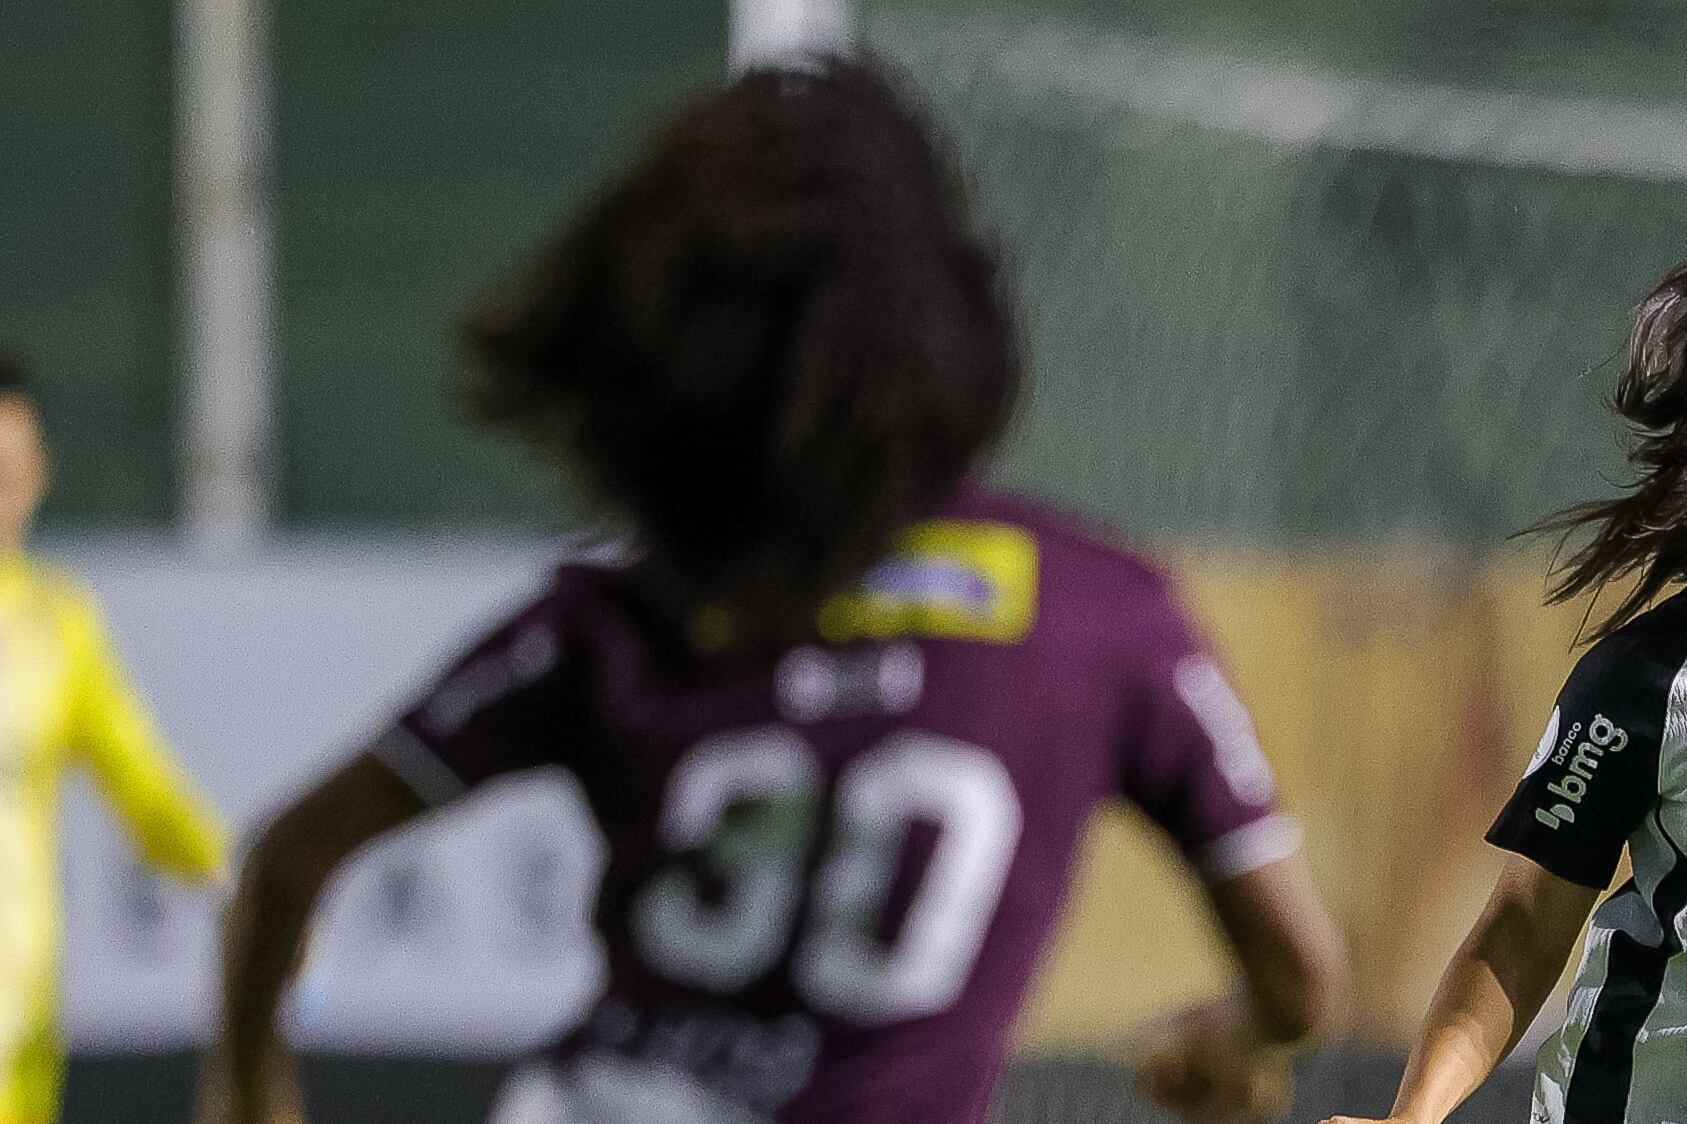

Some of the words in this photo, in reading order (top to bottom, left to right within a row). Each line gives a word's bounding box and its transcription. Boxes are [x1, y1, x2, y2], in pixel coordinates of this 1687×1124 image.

[1546, 713, 1629, 804] bmg
[1551, 721, 1582, 766] banco
[630, 725, 1024, 1026] 30
